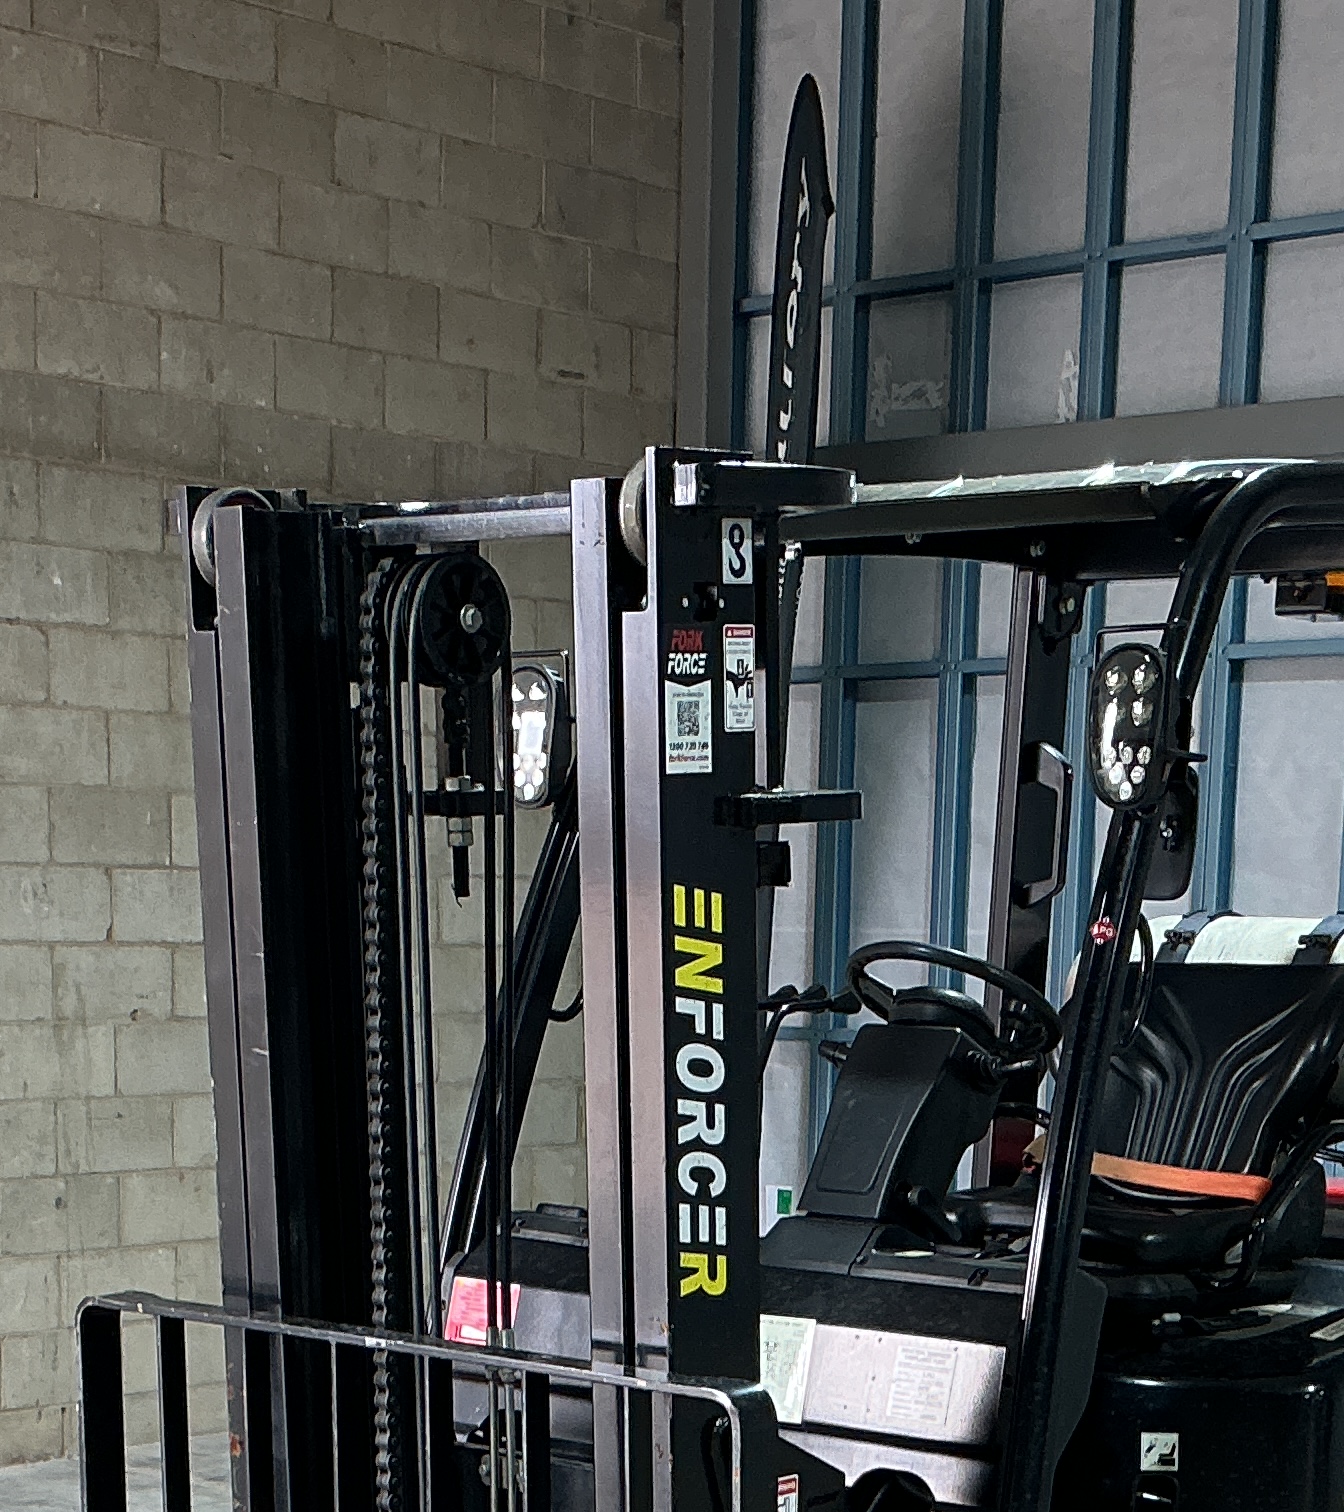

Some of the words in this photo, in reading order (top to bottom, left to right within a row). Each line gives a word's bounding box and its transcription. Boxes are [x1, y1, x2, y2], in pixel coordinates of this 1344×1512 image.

[671, 628, 705, 651] FORK
[667, 652, 708, 675] FORCE
[673, 884, 728, 1298] ENFORCER
